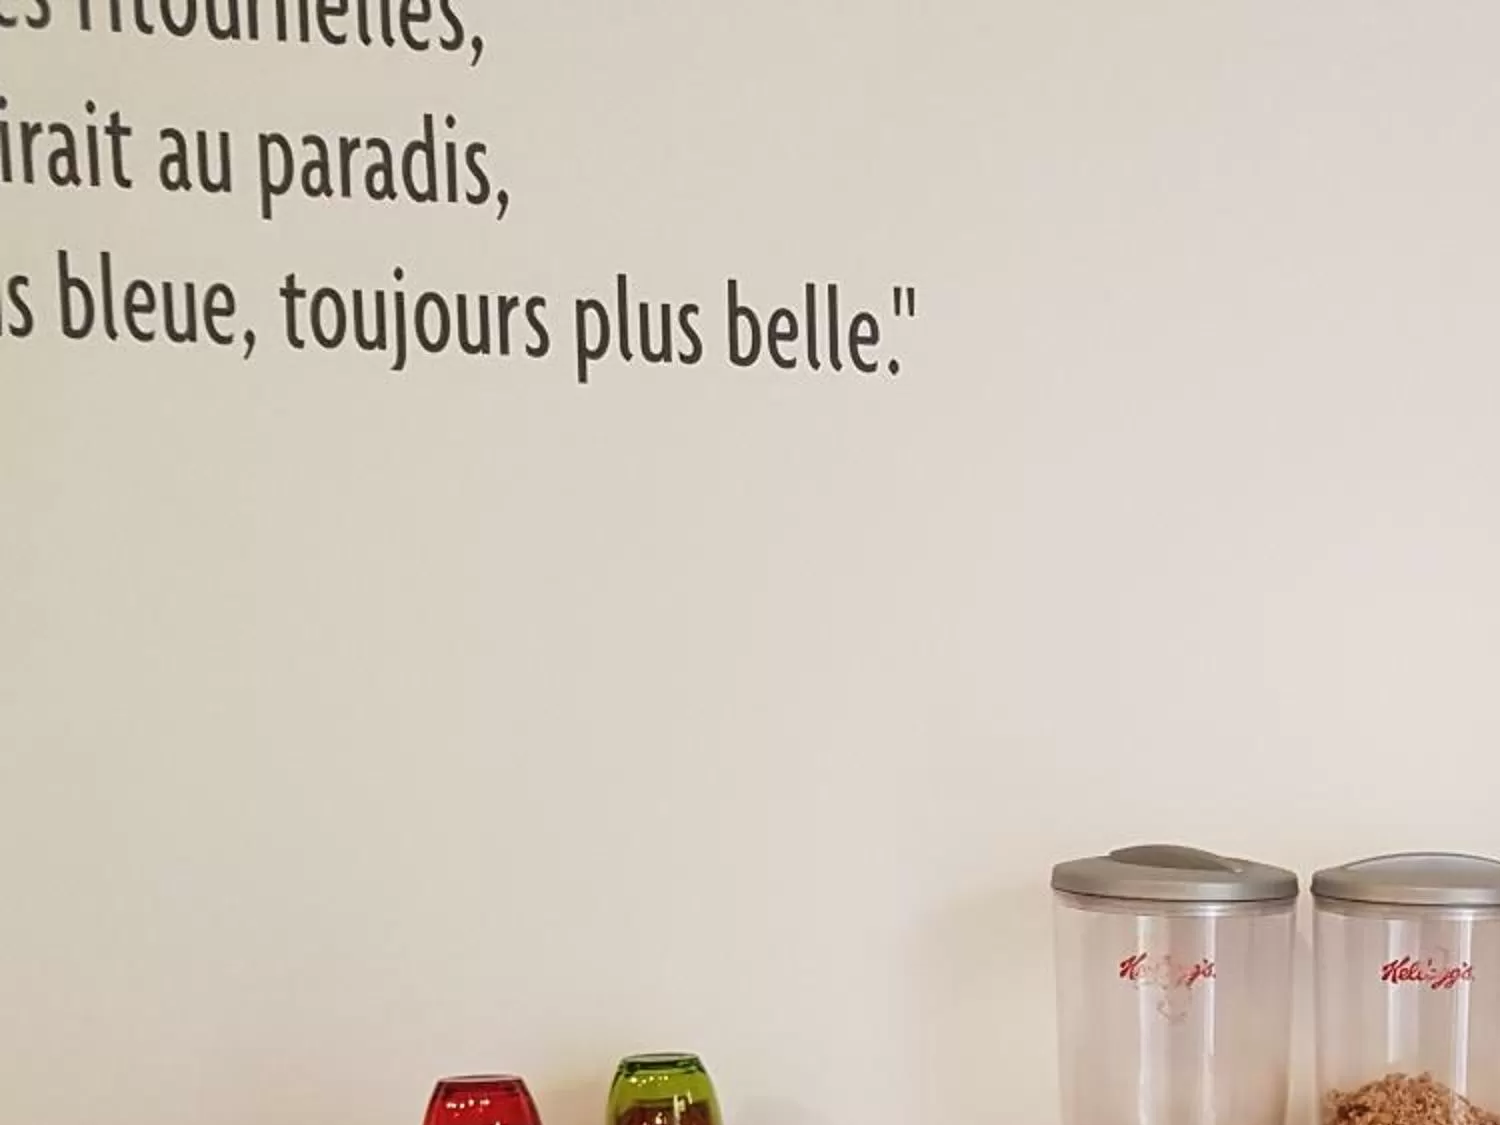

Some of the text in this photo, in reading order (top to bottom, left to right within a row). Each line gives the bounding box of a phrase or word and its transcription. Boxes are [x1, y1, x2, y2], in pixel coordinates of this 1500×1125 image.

[0, 96, 509, 220] irait au paradis,
[0, 250, 915, 383] s bleue, toujours plus belle."
